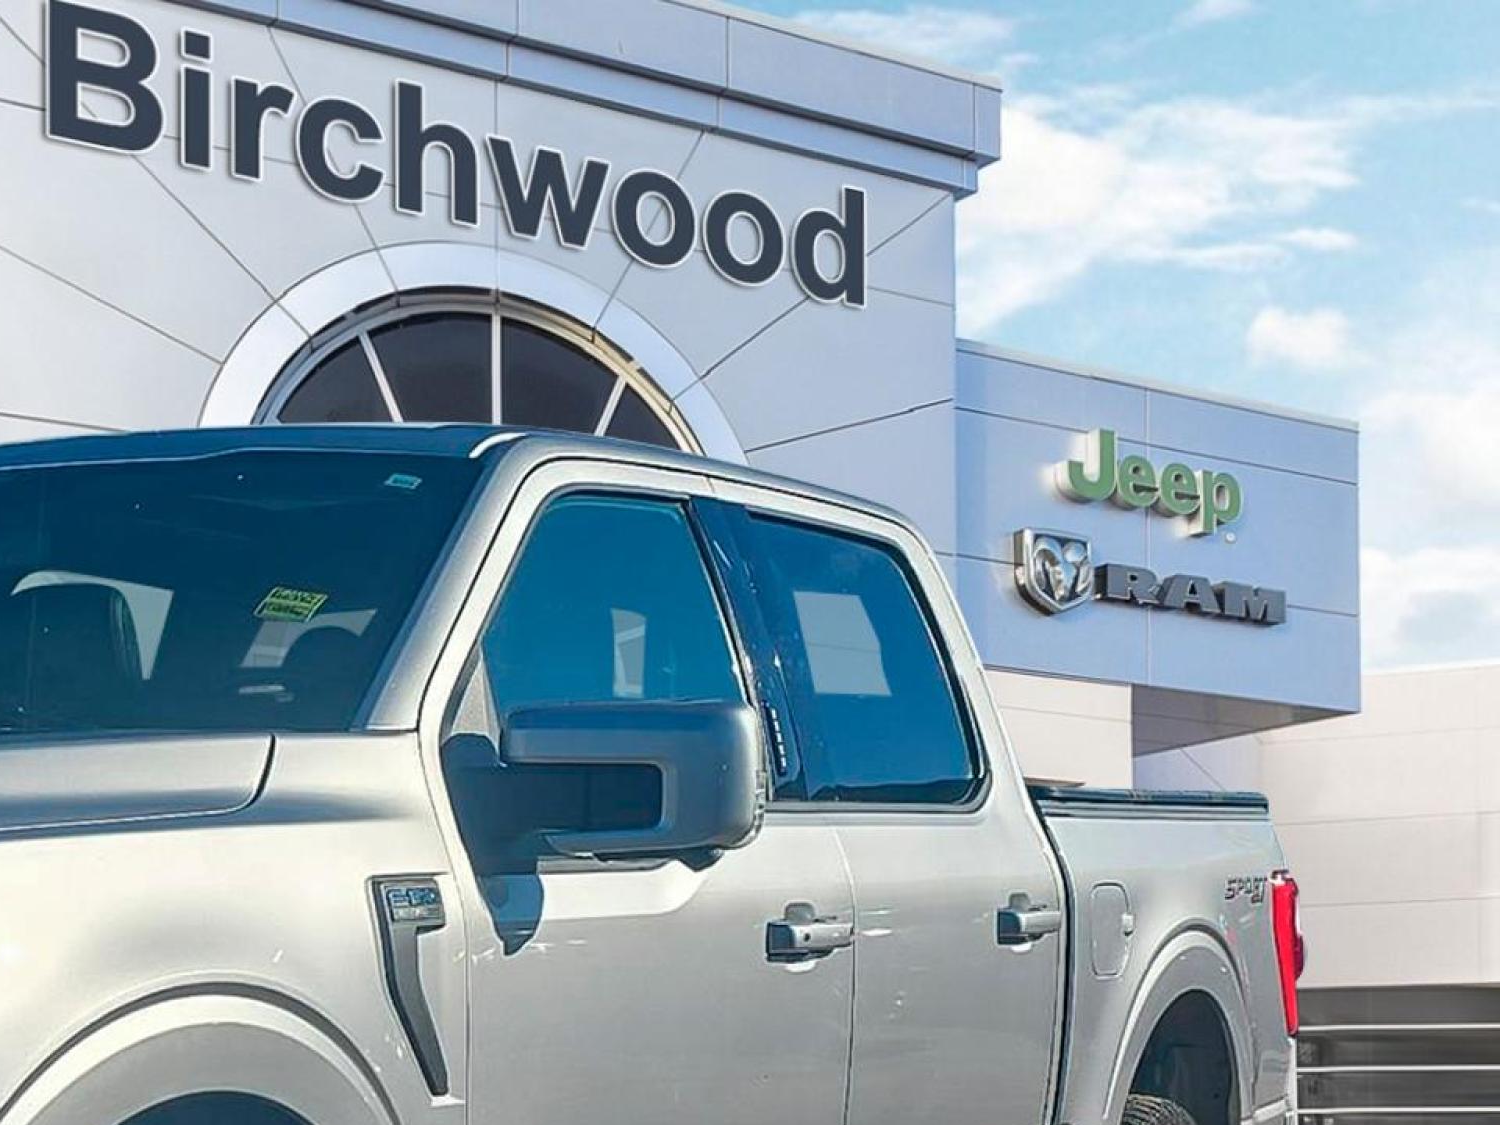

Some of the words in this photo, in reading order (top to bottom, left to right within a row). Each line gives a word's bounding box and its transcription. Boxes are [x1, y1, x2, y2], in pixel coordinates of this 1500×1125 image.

[45, 0, 867, 306] Birchwood
[1056, 427, 1244, 536] Jeep
[1095, 563, 1287, 625] RAM
